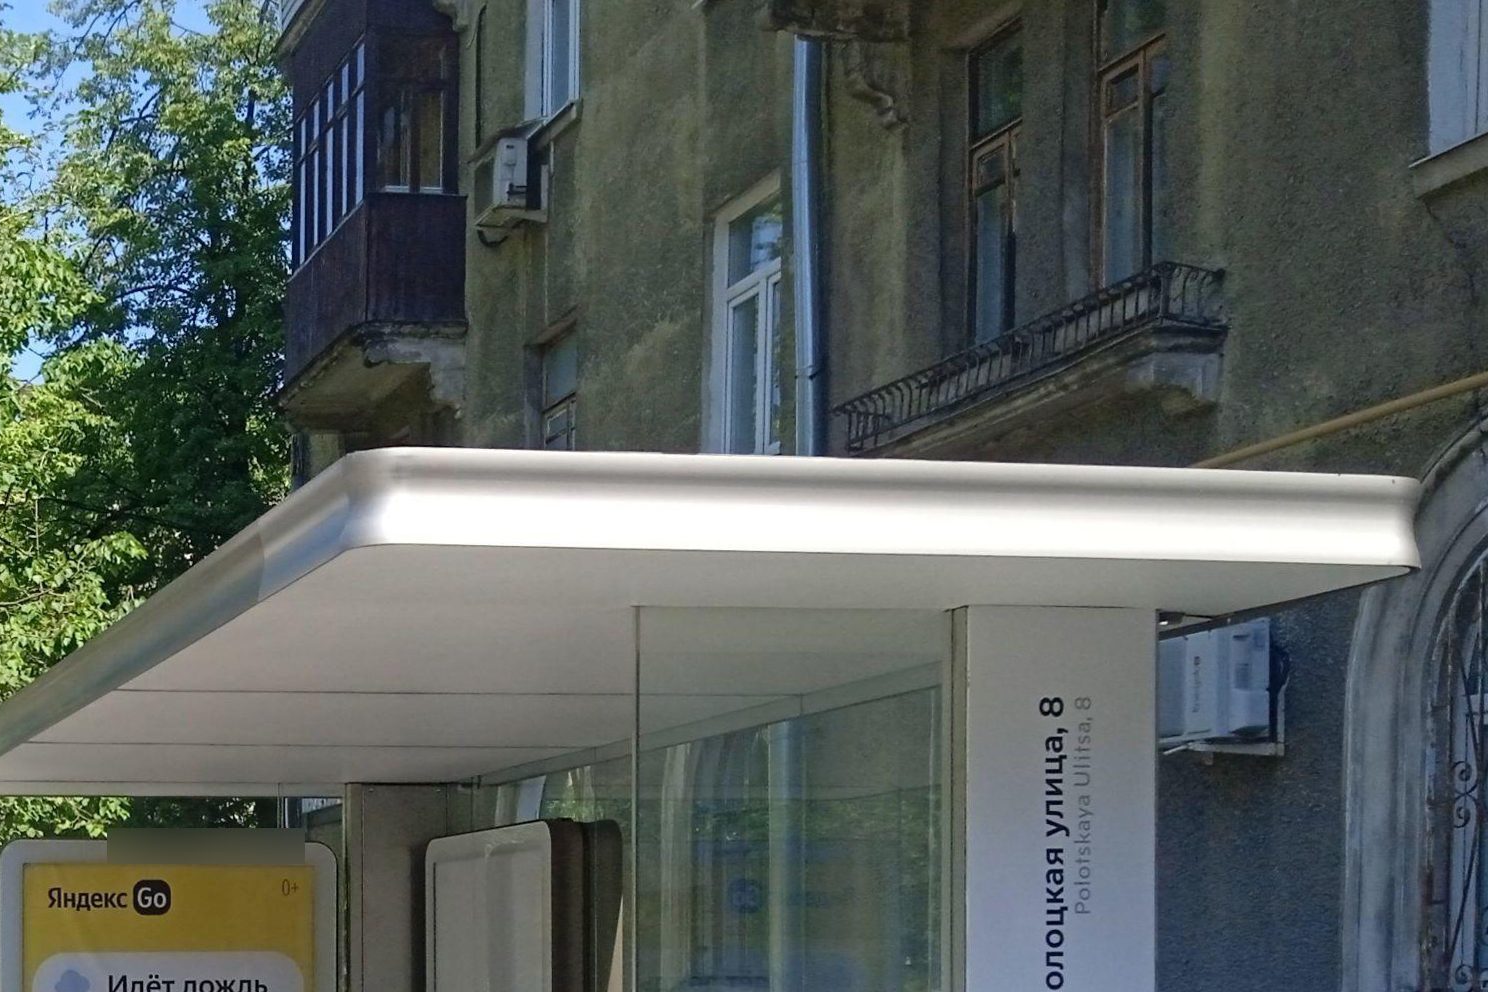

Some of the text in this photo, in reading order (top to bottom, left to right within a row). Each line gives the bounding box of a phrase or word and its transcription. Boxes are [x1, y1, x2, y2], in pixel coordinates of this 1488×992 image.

[1040, 696, 1064, 717] 8
[1044, 728, 1070, 838] улица,
[1074, 696, 1095, 915] Polotskaya Ulitsa, 8
[48, 886, 167, 910] Яндекс Go
[282, 879, 299, 897] 0+
